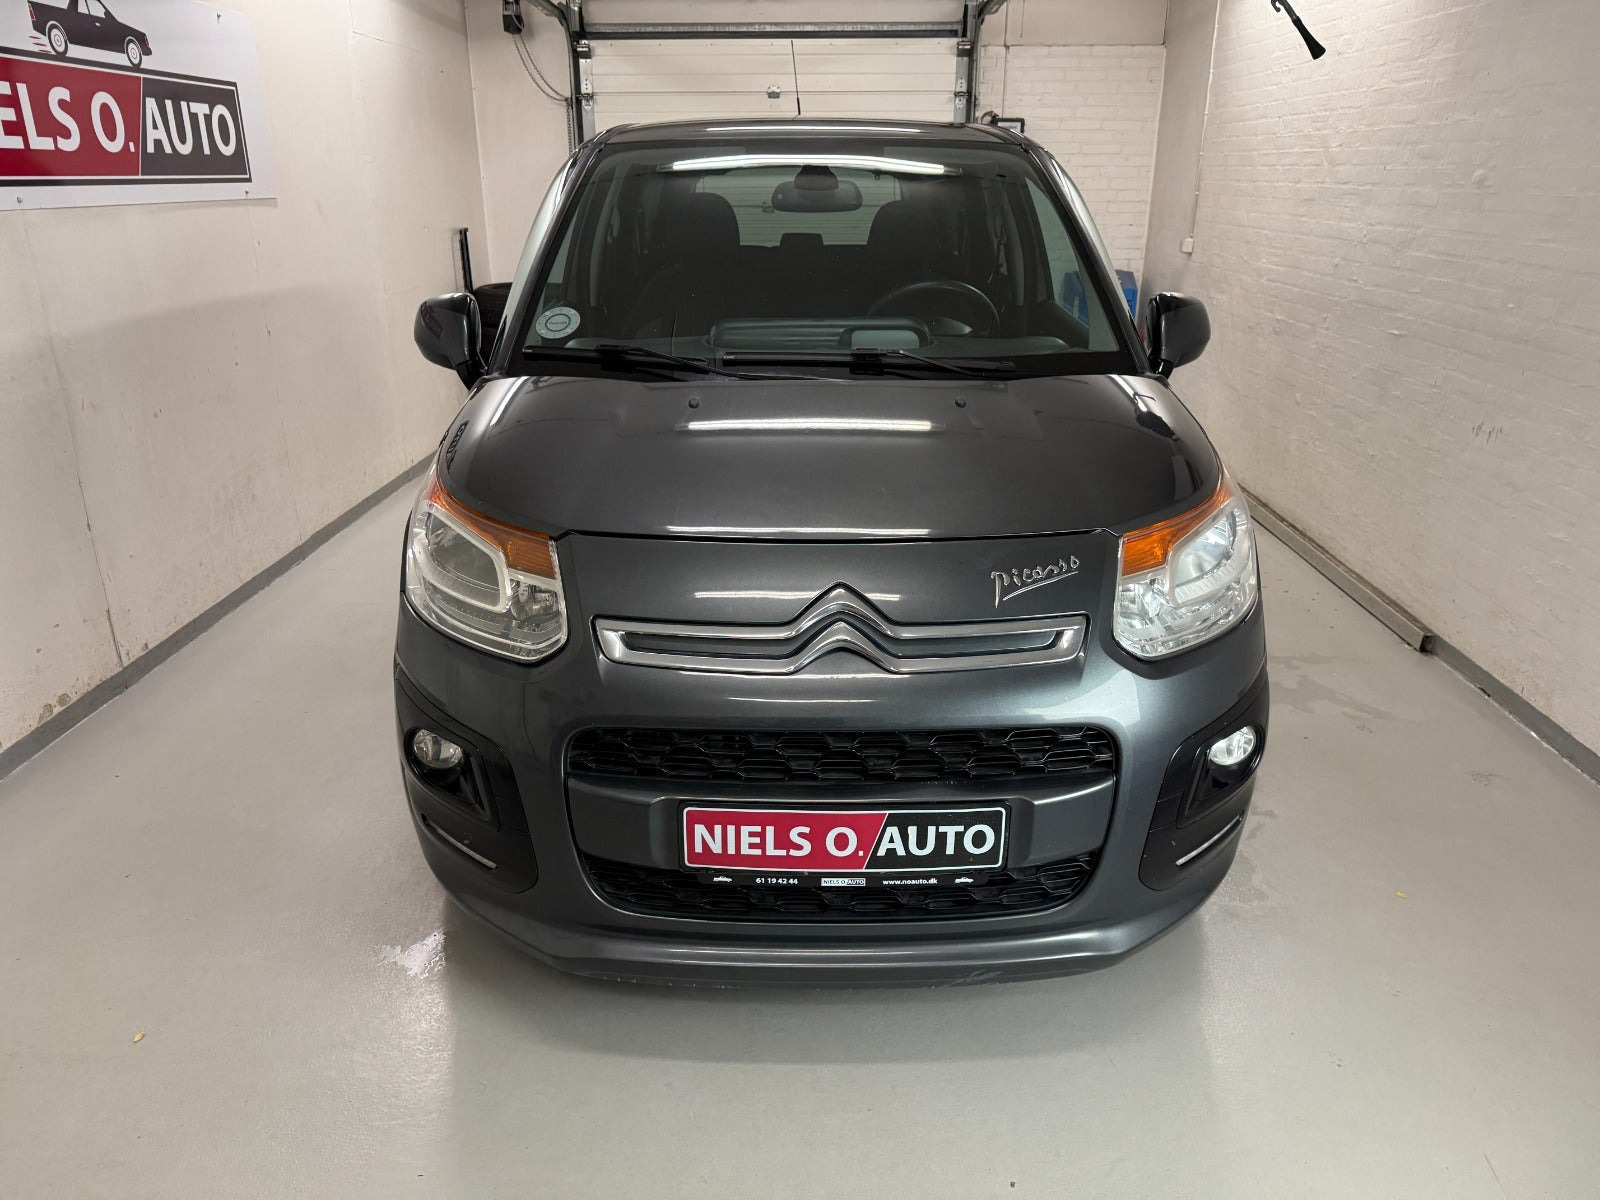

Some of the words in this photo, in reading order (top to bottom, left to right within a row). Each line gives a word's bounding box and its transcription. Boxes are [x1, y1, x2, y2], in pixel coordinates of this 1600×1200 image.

[90, 91, 136, 153] O.
[145, 97, 237, 156] AUTO
[693, 823, 812, 857] NIELS
[825, 826, 865, 857] O.
[876, 823, 996, 857] AUTO
[882, 877, 938, 885] www.noauto.dk
